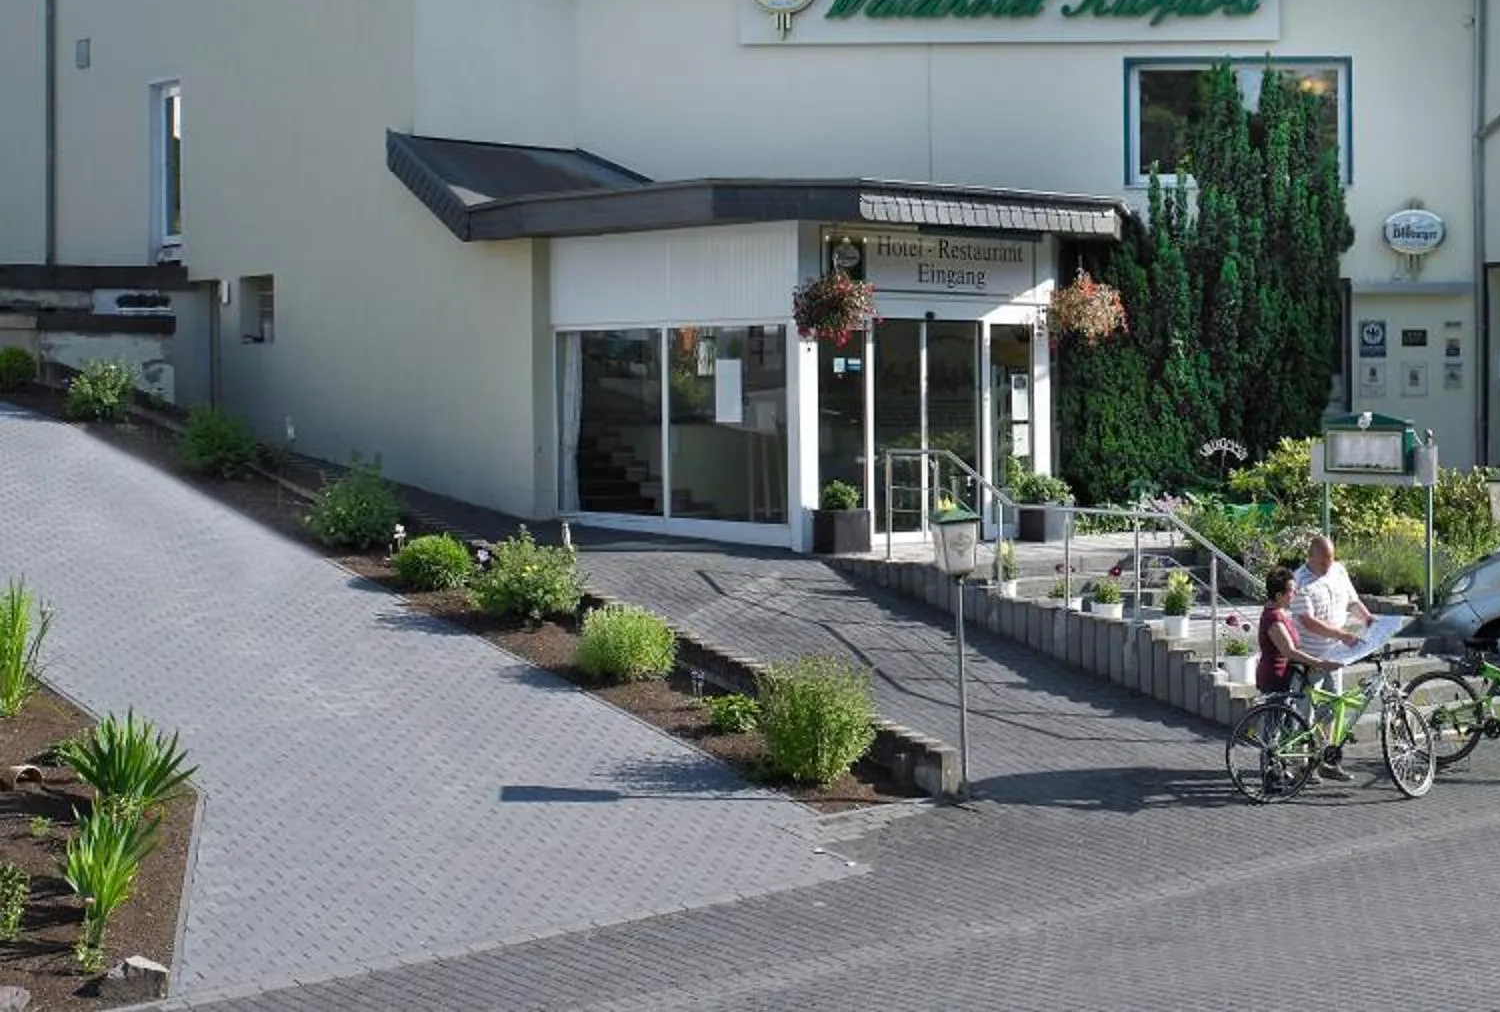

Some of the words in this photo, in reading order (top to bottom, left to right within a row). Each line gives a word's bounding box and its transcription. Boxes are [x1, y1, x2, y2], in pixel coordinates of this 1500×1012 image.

[877, 235, 923, 257] Hotel
[938, 238, 1023, 263] Restaurant
[918, 263, 985, 289] Eingang
